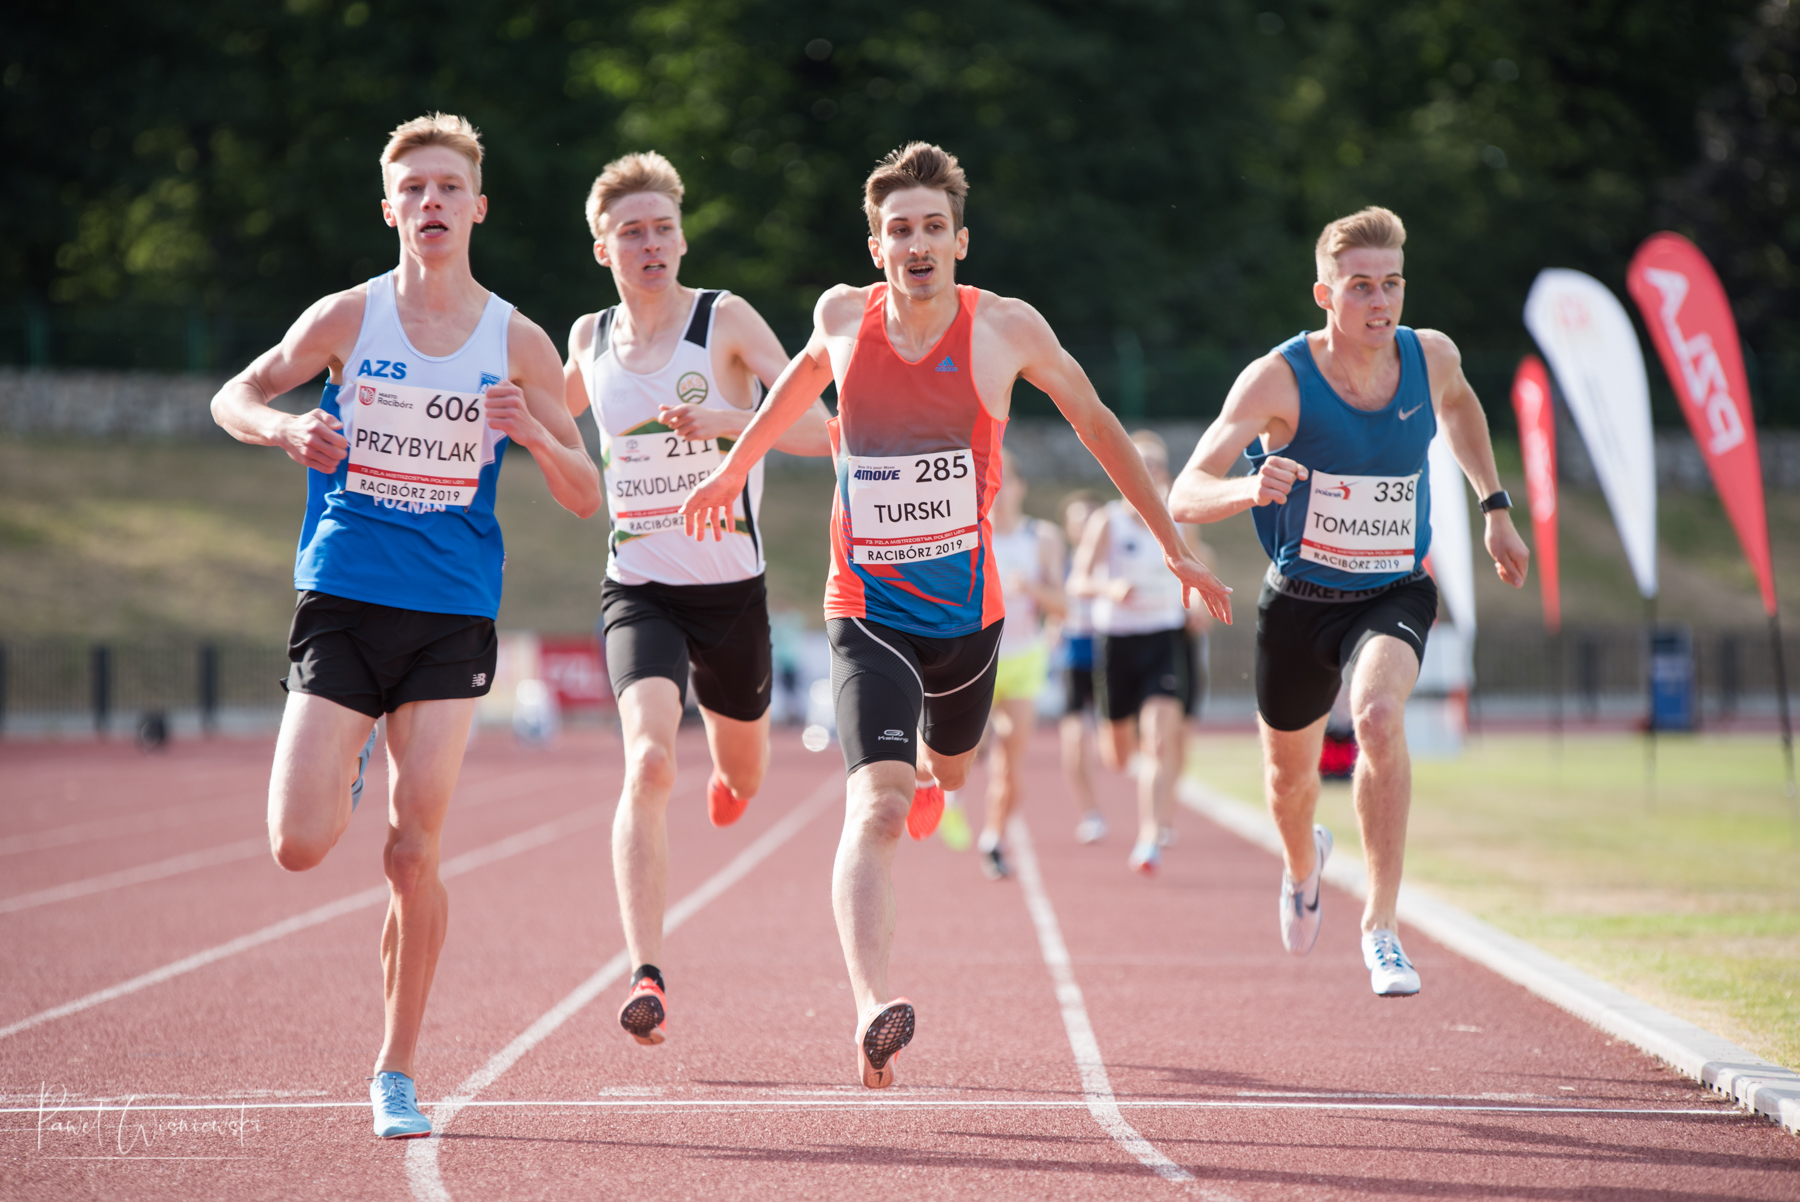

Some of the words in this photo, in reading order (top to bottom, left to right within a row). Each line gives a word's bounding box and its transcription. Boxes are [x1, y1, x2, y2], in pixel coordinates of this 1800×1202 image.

[357, 359, 408, 380] AZS
[377, 396, 414, 409] Racibórz
[425, 394, 480, 423] 606
[355, 428, 478, 463] PRZYBYLAK
[664, 436, 713, 458] 211
[853, 469, 901, 481] 4MOVE
[914, 455, 968, 483] 285
[359, 478, 426, 499] RACIBÓRZ
[429, 489, 461, 502] 2019
[616, 467, 717, 498] SZKUDLARE
[1374, 480, 1415, 503] 338
[873, 499, 952, 524] TURSKI
[629, 515, 685, 532] RACIBÓRZ
[1313, 511, 1413, 536] TOMASIAK
[890, 536, 933, 545] MISTRZOSTWA
[933, 532, 953, 540] POLSKI
[867, 545, 932, 561] RACIBÓRZ
[935, 539, 964, 556] 2019
[1313, 551, 1371, 570] RACIBÓRZ
[1373, 559, 1400, 570] 2019
[1286, 578, 1335, 600] NIKE
